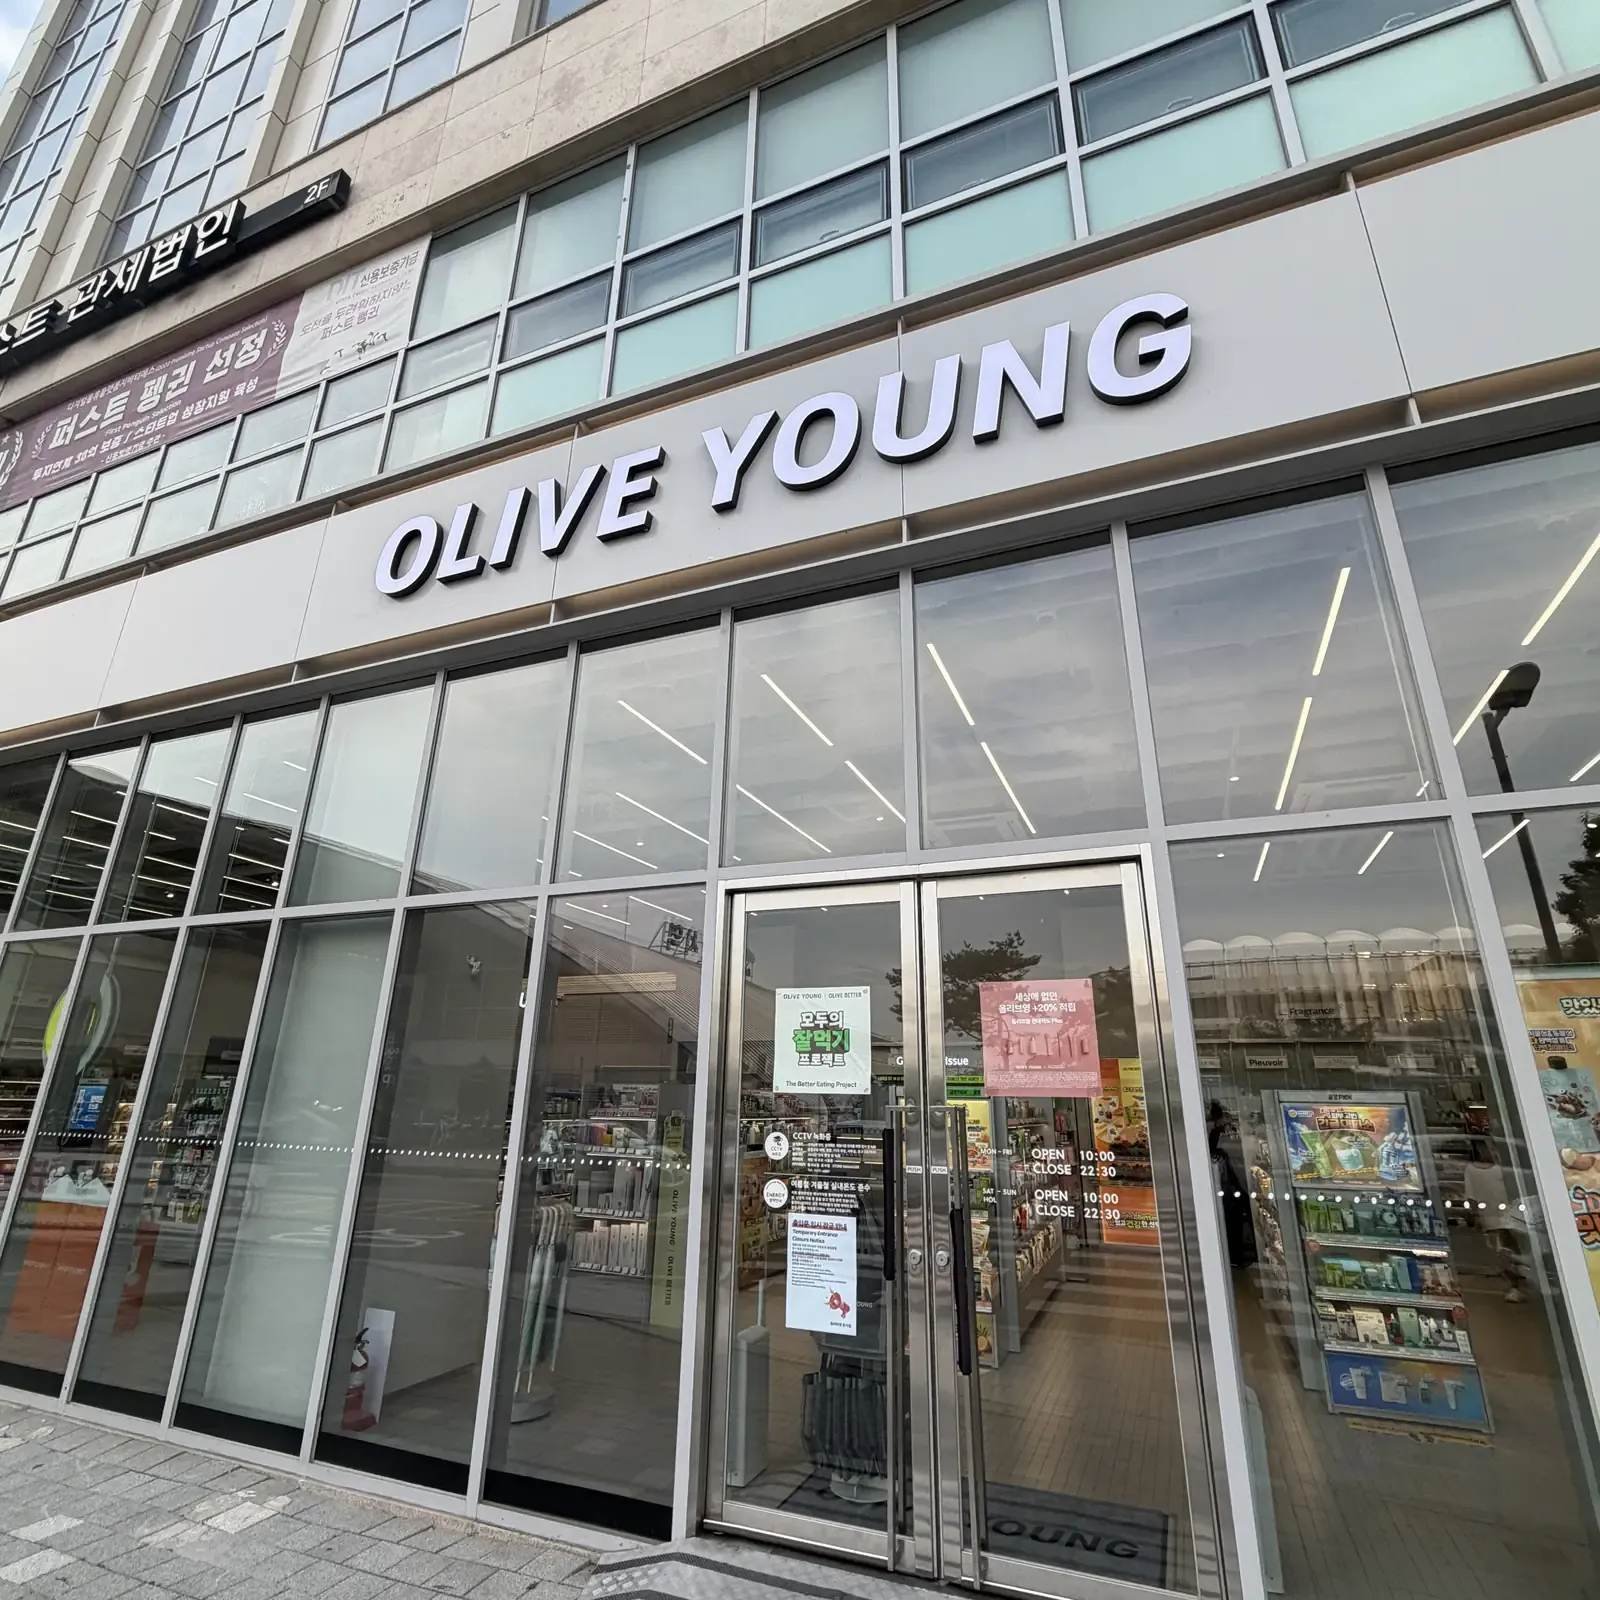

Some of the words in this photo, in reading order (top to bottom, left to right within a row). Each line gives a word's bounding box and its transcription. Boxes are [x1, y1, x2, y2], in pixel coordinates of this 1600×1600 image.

[304, 178, 331, 205] 2F
[66, 199, 238, 322] 관세법인
[360, 250, 419, 288] 신용보증기금
[321, 315, 355, 340] 퍼스트
[48, 390, 130, 450] 퍼스트
[137, 359, 196, 413] 펭귄
[203, 328, 268, 384] 선정
[132, 409, 180, 440] 스타트업
[181, 388, 231, 420] 성장지원
[233, 375, 259, 397] 육성
[375, 444, 667, 599] OLIVE
[701, 292, 1192, 514] YOUNG
[802, 992, 822, 1000] YOUNG
[1014, 992, 1039, 1002] 세상에
[998, 1003, 1031, 1014] 올리브영
[1032, 1003, 1058, 1013] +20%
[1289, 1007, 1336, 1017] Fragrance
[1560, 997, 1600, 1016] 맛있
[800, 1010, 845, 1029] 모두의
[792, 1028, 850, 1054] 잘먹기
[797, 1052, 847, 1068] 프로젝트
[945, 1056, 969, 1066] Issue
[816, 1081, 835, 1089] Eating
[835, 1081, 857, 1089] Project
[792, 1131, 813, 1141] CCTV
[1031, 1148, 1065, 1160] OPEN
[1080, 1150, 1116, 1162] 10:00
[1033, 1162, 1072, 1176] CLOSE
[1080, 1165, 1117, 1177] 22:30
[811, 1180, 830, 1191] 겨울철
[831, 1181, 857, 1192] 실내온도
[857, 1183, 871, 1193] 준수
[1002, 1188, 1017, 1196] SUN
[671, 1189, 680, 1213] OLIVE
[1034, 1189, 1069, 1201] OPEN
[1083, 1192, 1120, 1204] 10:00
[1035, 1204, 1075, 1217] CLOSE
[1084, 1207, 1121, 1220] 22:30
[669, 1216, 678, 1246] YOUNG
[792, 1229, 817, 1237] Temporary
[817, 1230, 839, 1238] Entrance
[989, 1519, 1141, 1559] OUNG
